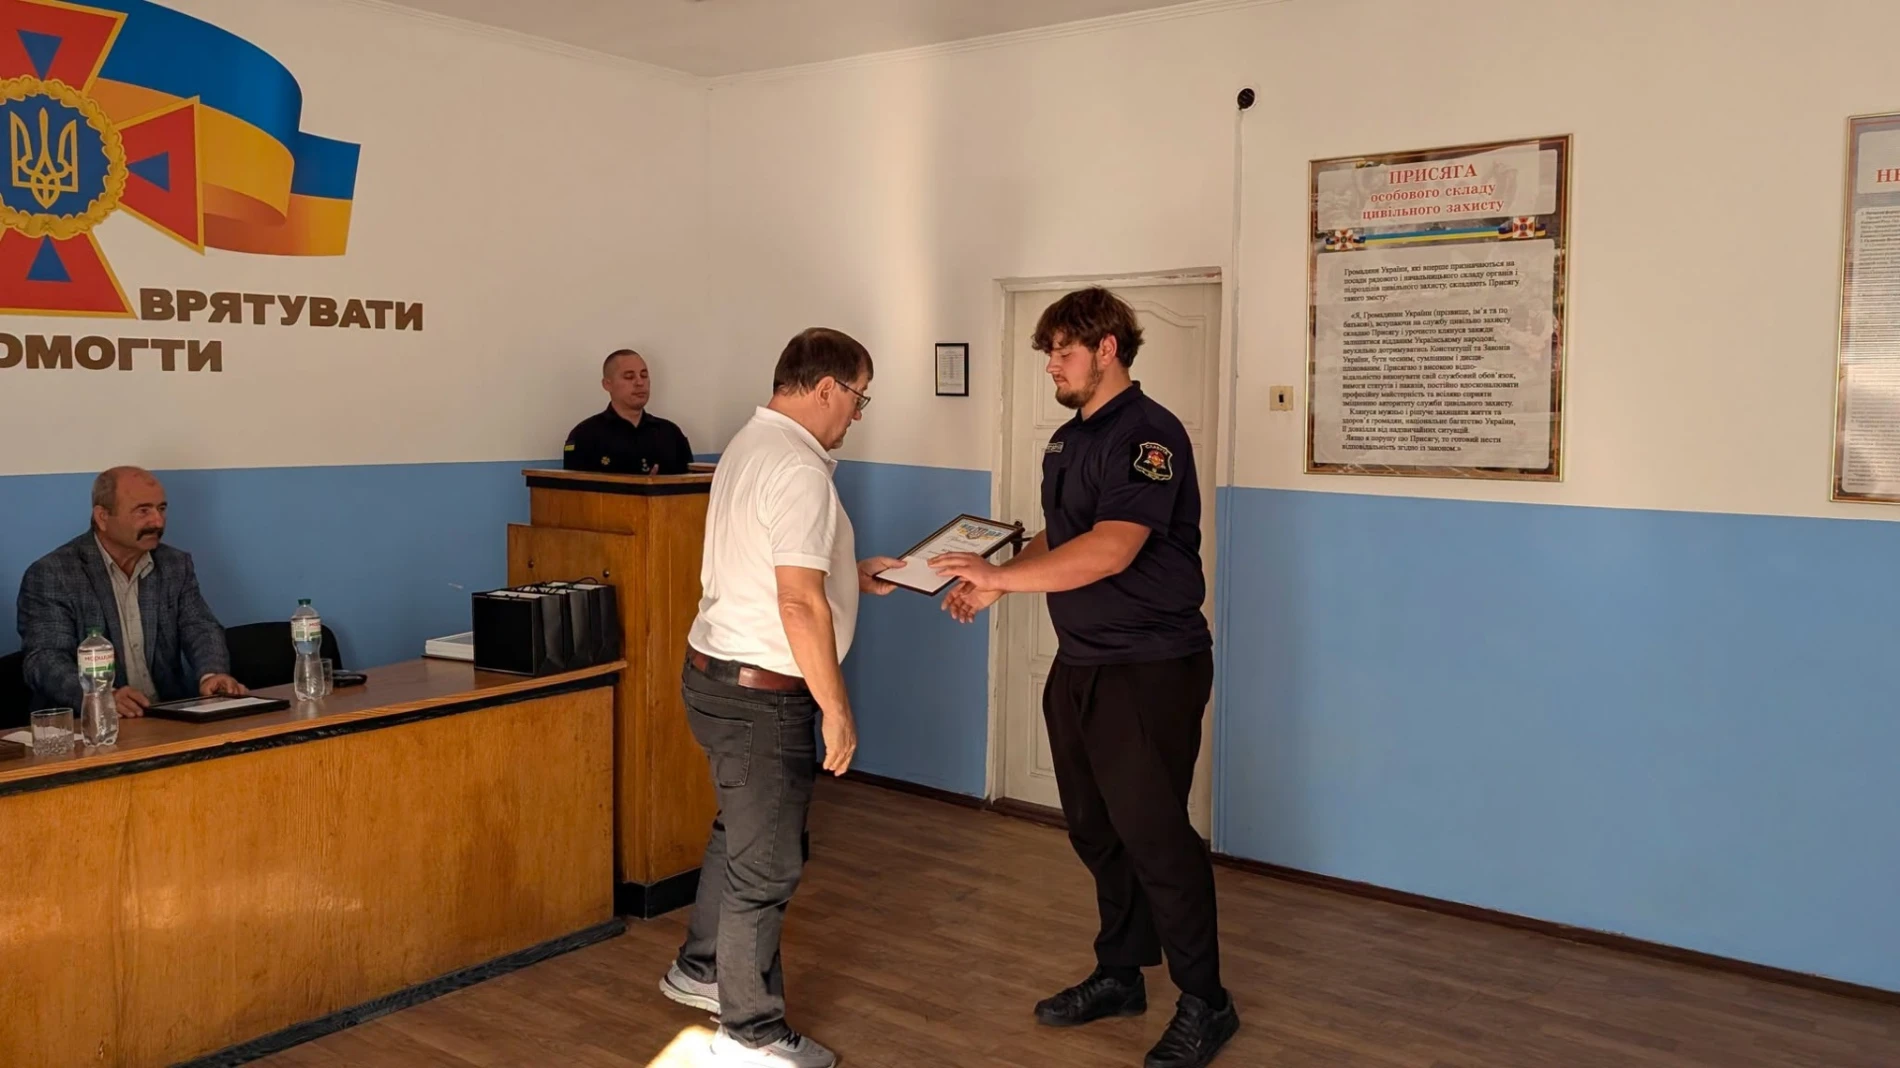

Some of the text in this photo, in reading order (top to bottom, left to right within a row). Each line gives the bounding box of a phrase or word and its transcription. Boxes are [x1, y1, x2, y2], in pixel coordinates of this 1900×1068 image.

[1389, 163, 1477, 184] ПРИСЯГА
[1370, 184, 1496, 203] особового складу
[1362, 200, 1505, 220] цивільного захисту
[140, 288, 424, 331] ВРЯТУВАТИ
